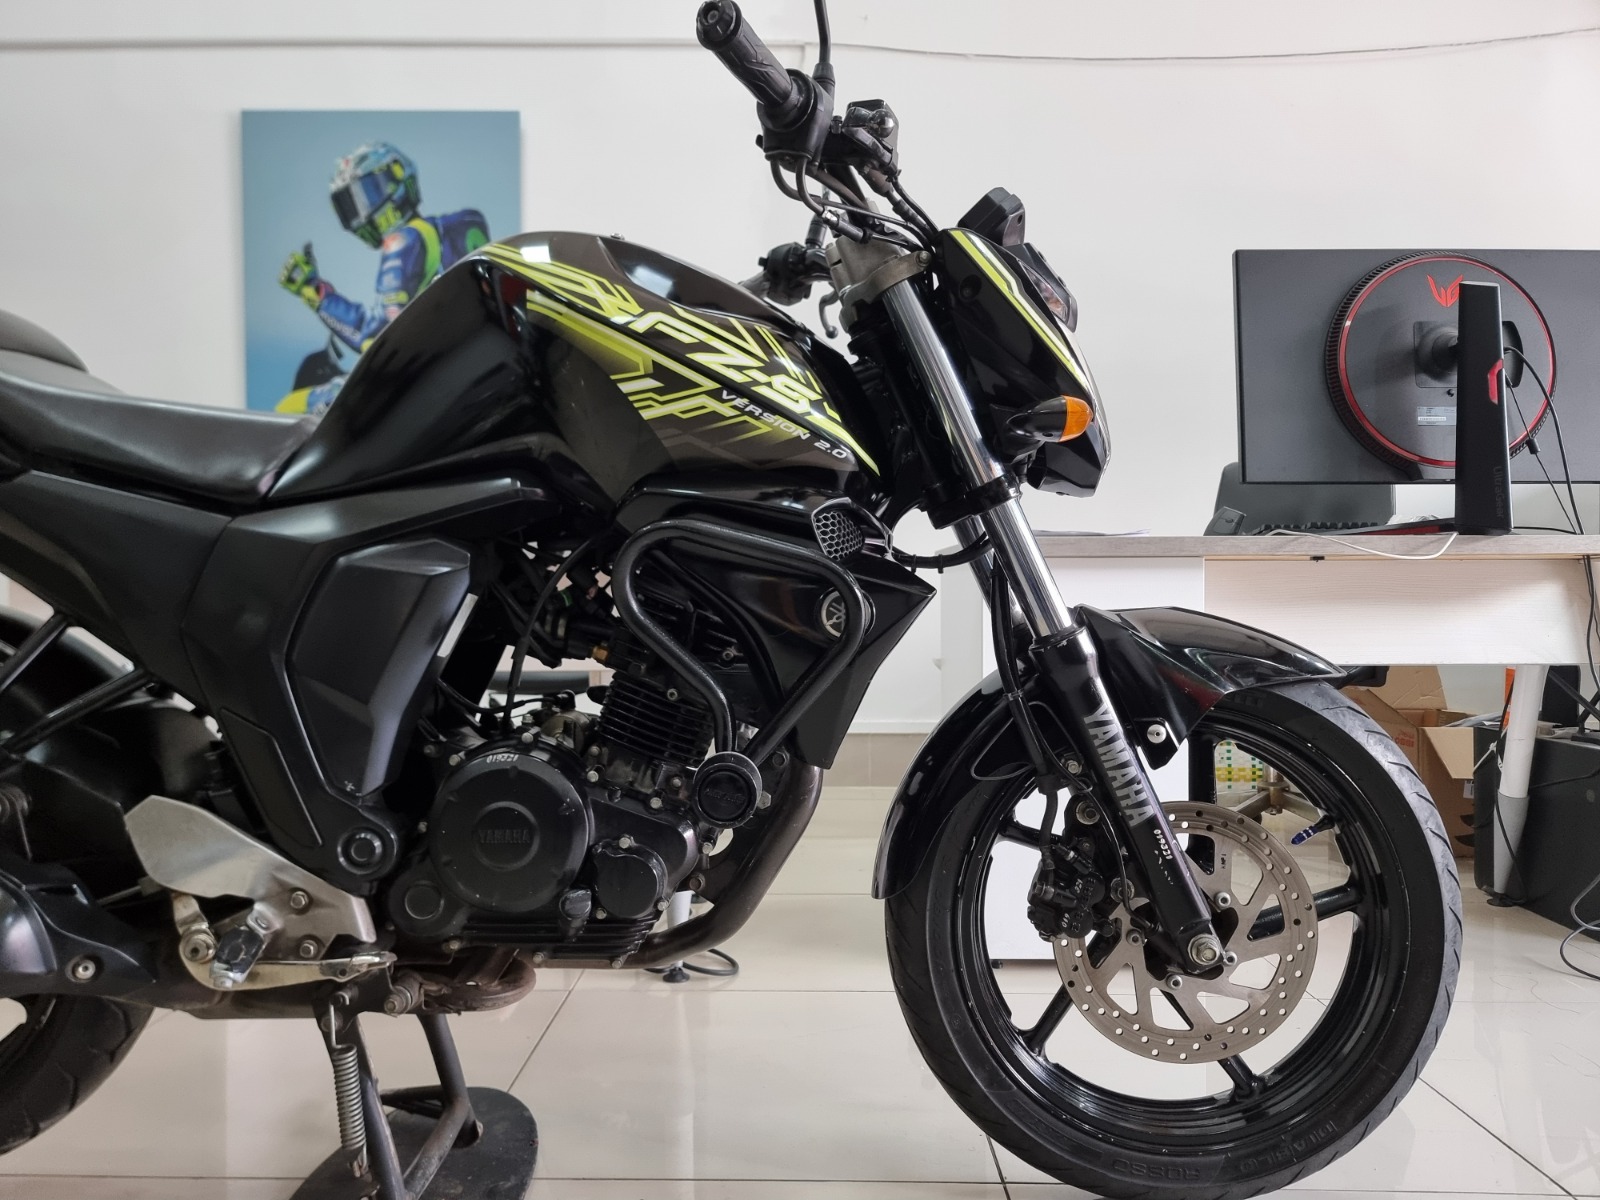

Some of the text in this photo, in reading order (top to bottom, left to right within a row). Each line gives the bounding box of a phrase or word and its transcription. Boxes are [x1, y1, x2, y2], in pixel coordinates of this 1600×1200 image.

[722, 390, 847, 459] VERSION 2.0
[1493, 465, 1505, 519] UltraGear
[1084, 703, 1155, 827] YAMAHA
[478, 829, 530, 844] YAMAHA
[1154, 829, 1173, 860] 019321
[1111, 1159, 1201, 1182] ROSSO
